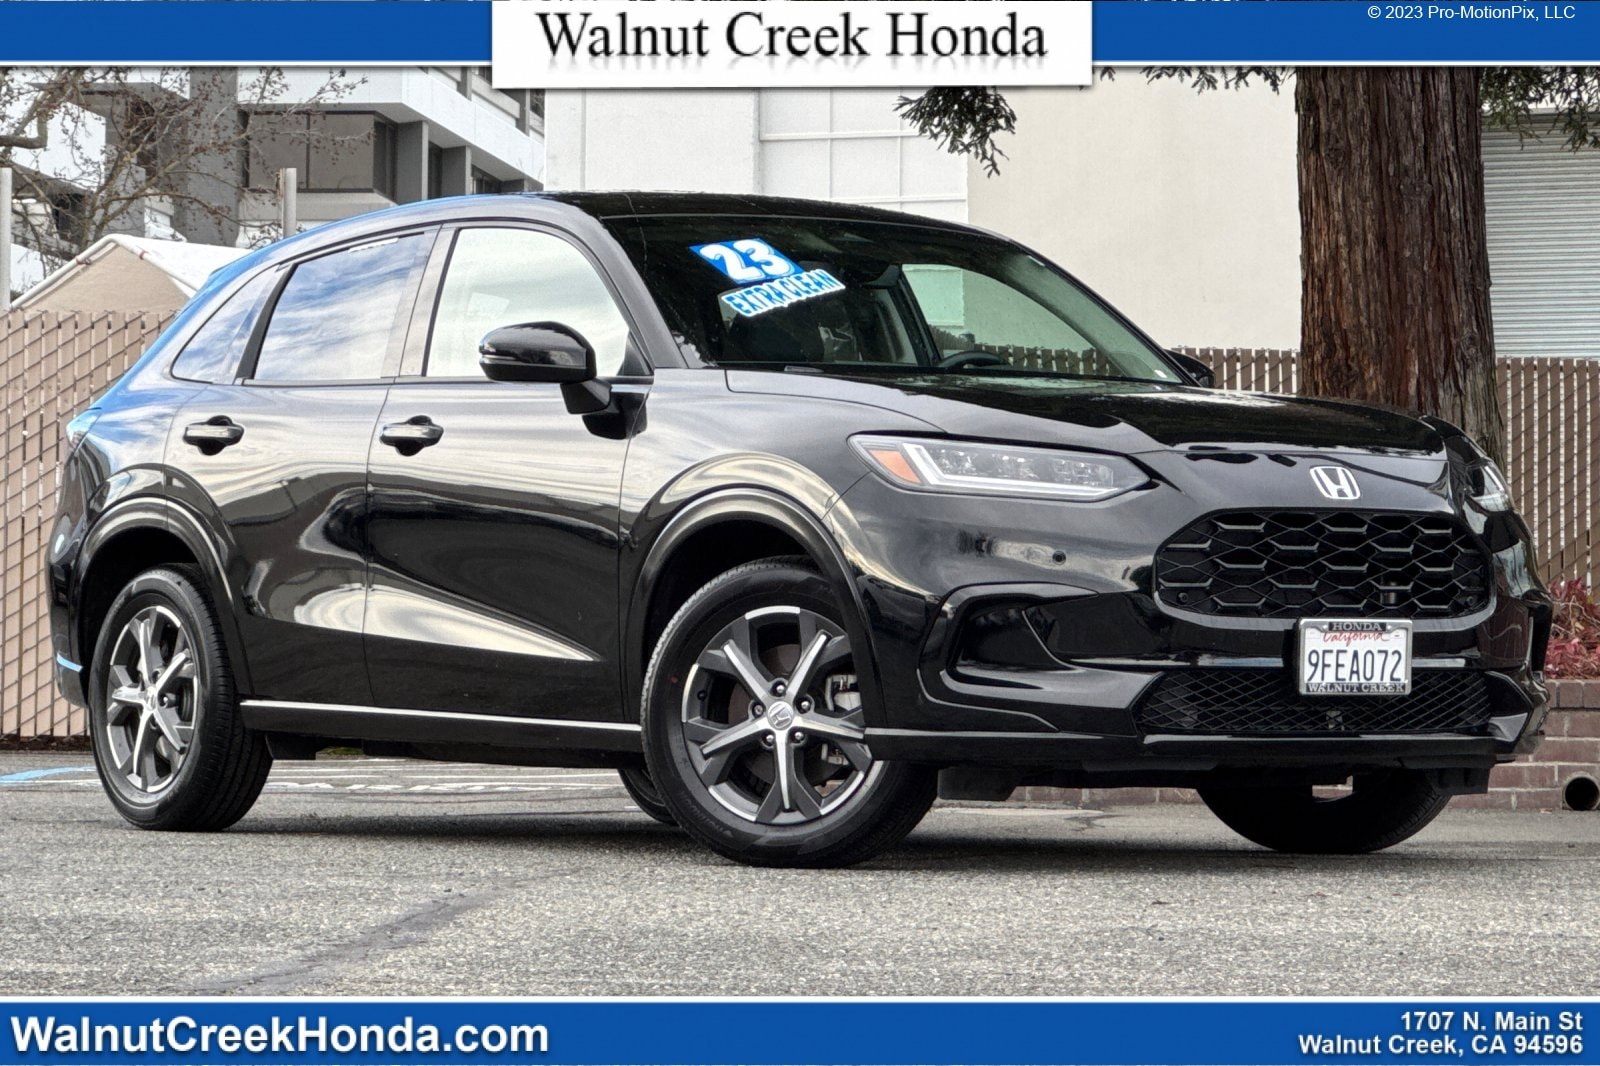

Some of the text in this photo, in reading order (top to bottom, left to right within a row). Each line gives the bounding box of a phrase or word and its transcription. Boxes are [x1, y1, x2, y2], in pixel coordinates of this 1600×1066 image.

[699, 238, 795, 281] 23
[1333, 621, 1382, 631] HONDA
[1307, 649, 1402, 682] 9FEA072
[1308, 682, 1405, 693] WALNUT CREEK
